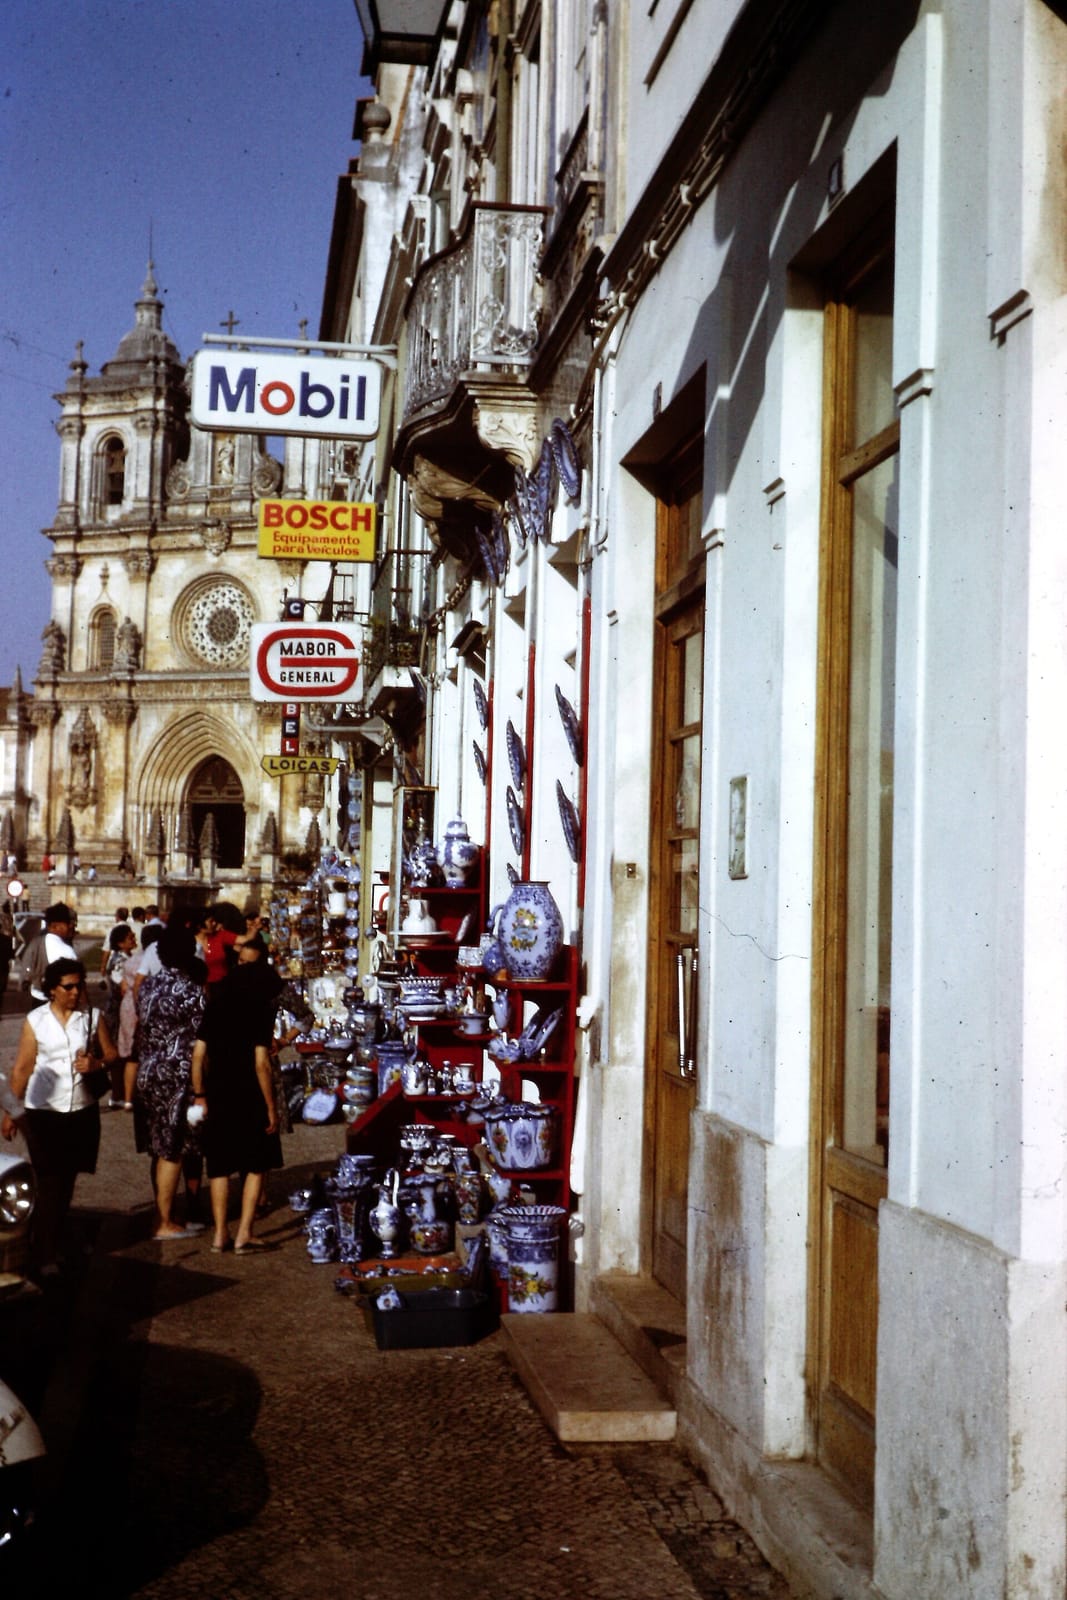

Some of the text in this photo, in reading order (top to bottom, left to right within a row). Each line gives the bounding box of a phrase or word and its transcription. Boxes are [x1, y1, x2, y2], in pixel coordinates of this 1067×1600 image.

[208, 365, 367, 421] Mobil
[263, 503, 372, 532] BOSCH
[273, 530, 360, 545] Equipamento
[273, 544, 304, 556] para
[280, 641, 336, 656] MABOR
[280, 671, 336, 683] GENERAL
